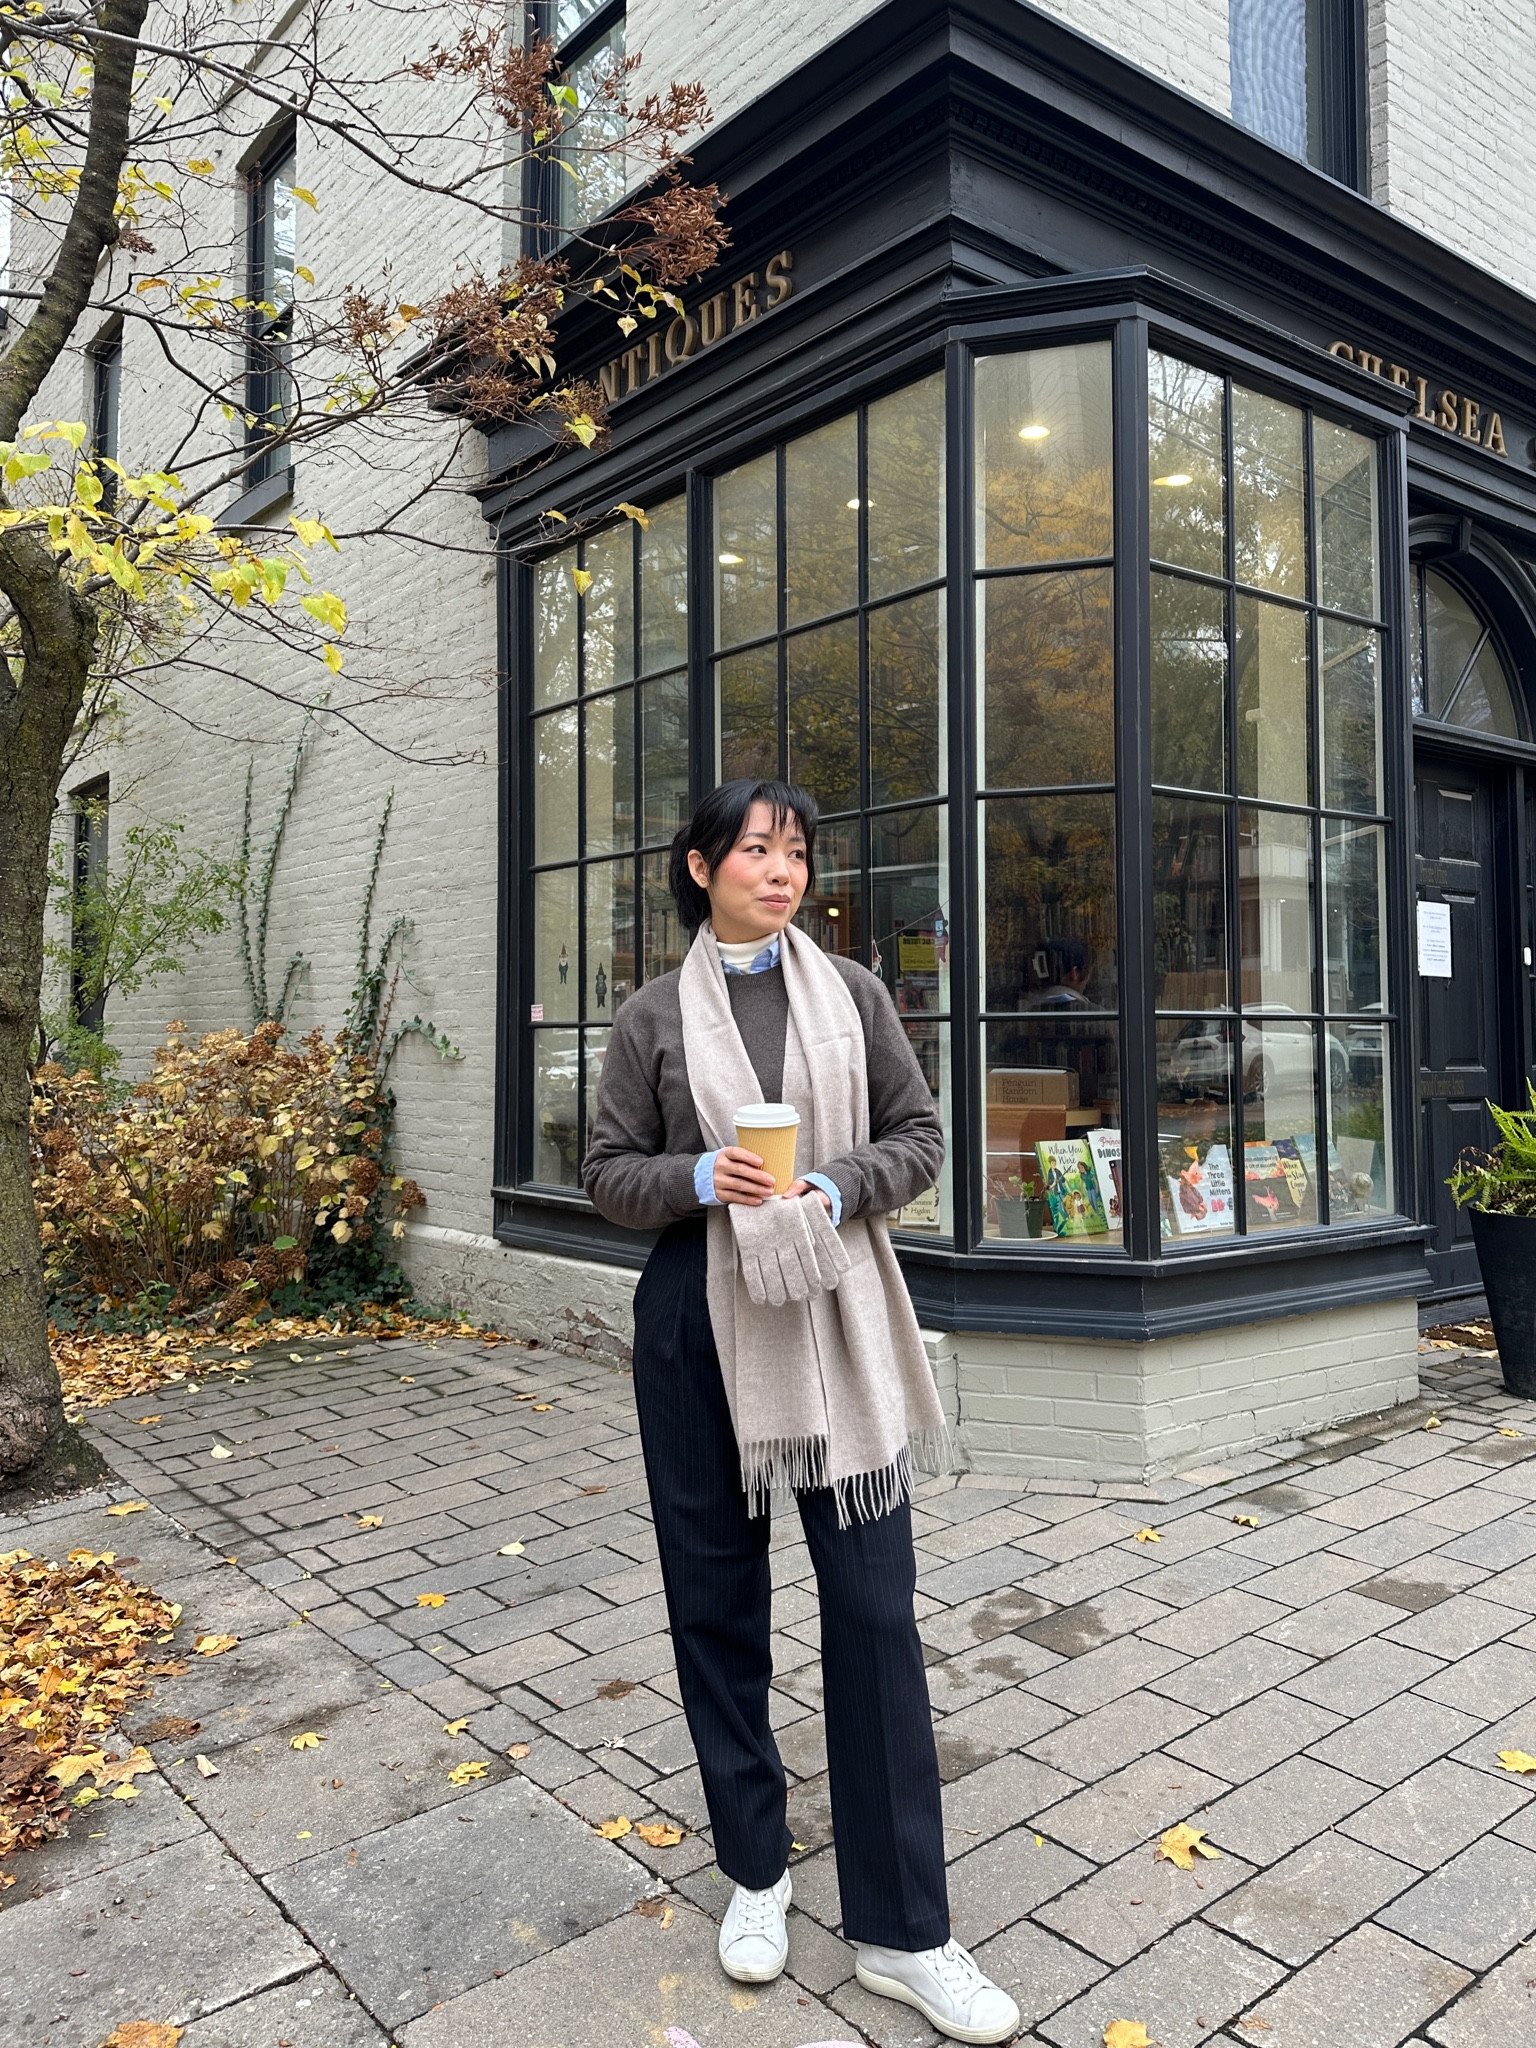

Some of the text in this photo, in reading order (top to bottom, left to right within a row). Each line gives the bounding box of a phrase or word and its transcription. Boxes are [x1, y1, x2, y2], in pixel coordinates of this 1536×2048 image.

[599, 250, 793, 404] NTIQUES
[1002, 1078, 1037, 1088] Penguin
[1002, 1086, 1037, 1095] Random
[1002, 1095, 1028, 1103] House
[1048, 1143, 1083, 1157] When You
[1097, 1148, 1121, 1158] DINOS
[1058, 1155, 1077, 1164] Were
[1207, 1171, 1225, 1179] Three
[1209, 1188, 1231, 1196] Mittens
[911, 1206, 931, 1216] Higdon
